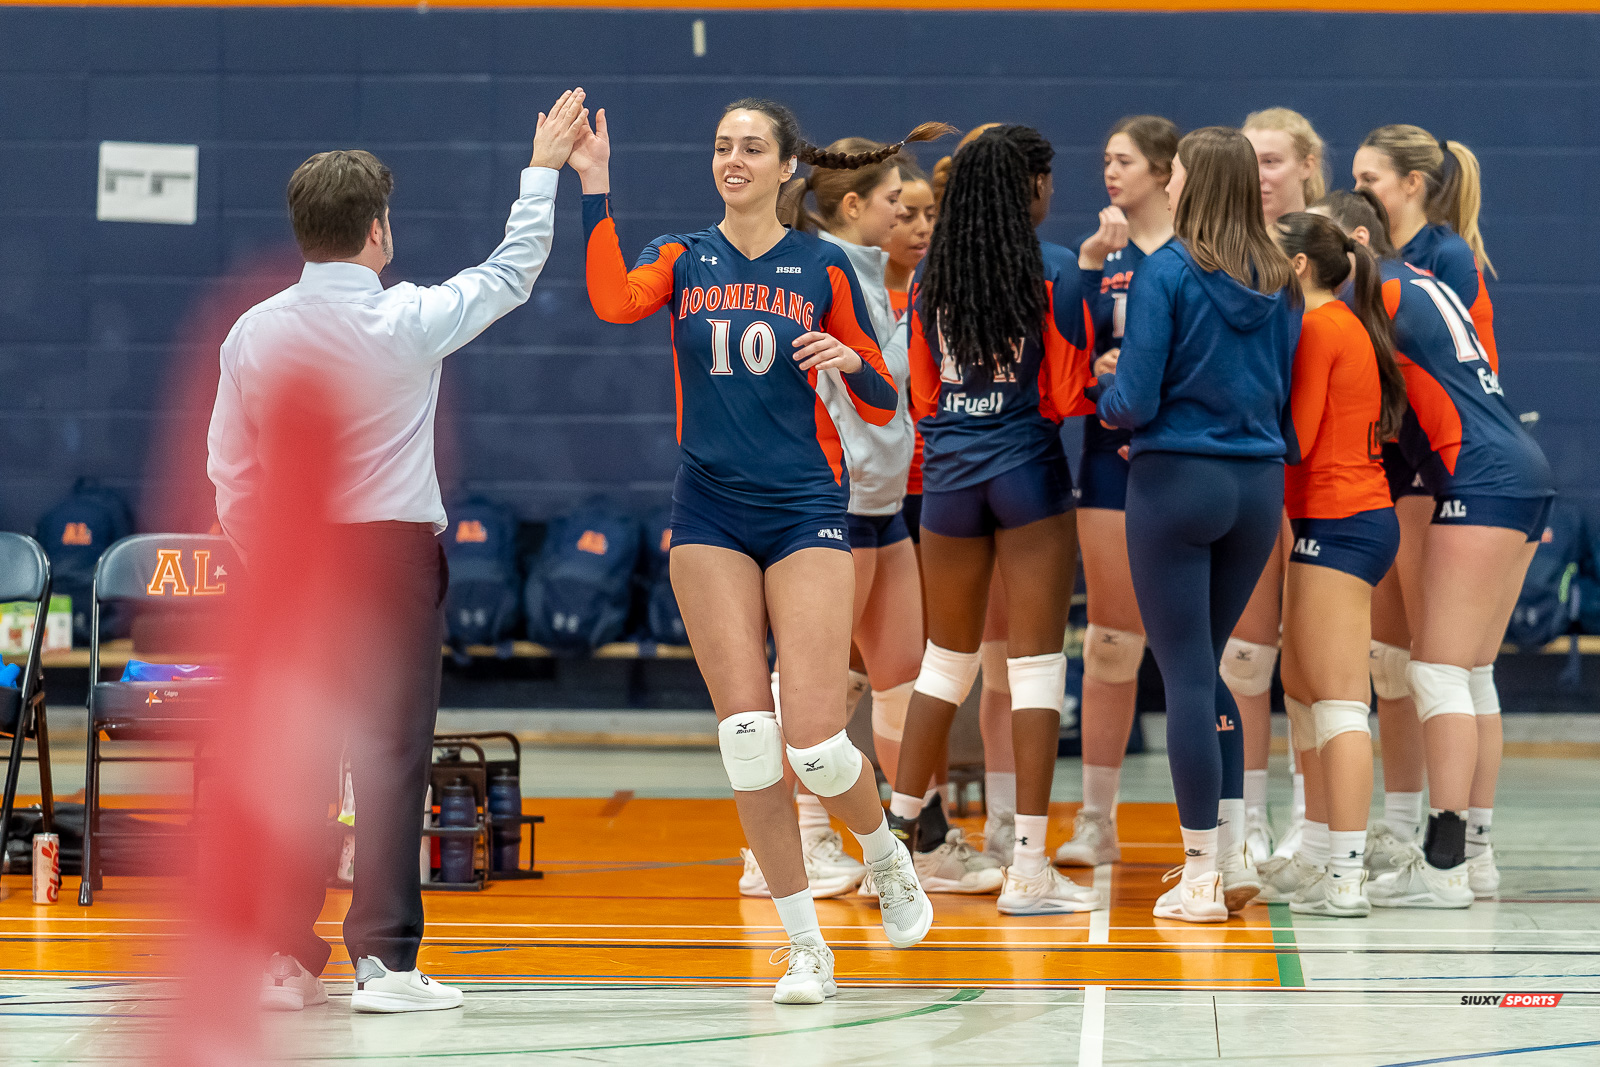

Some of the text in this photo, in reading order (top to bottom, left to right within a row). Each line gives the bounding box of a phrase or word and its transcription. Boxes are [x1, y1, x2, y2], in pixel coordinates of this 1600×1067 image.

[775, 266, 802, 274] RSEQ
[705, 318, 777, 376] 10
[146, 548, 226, 597] AL
